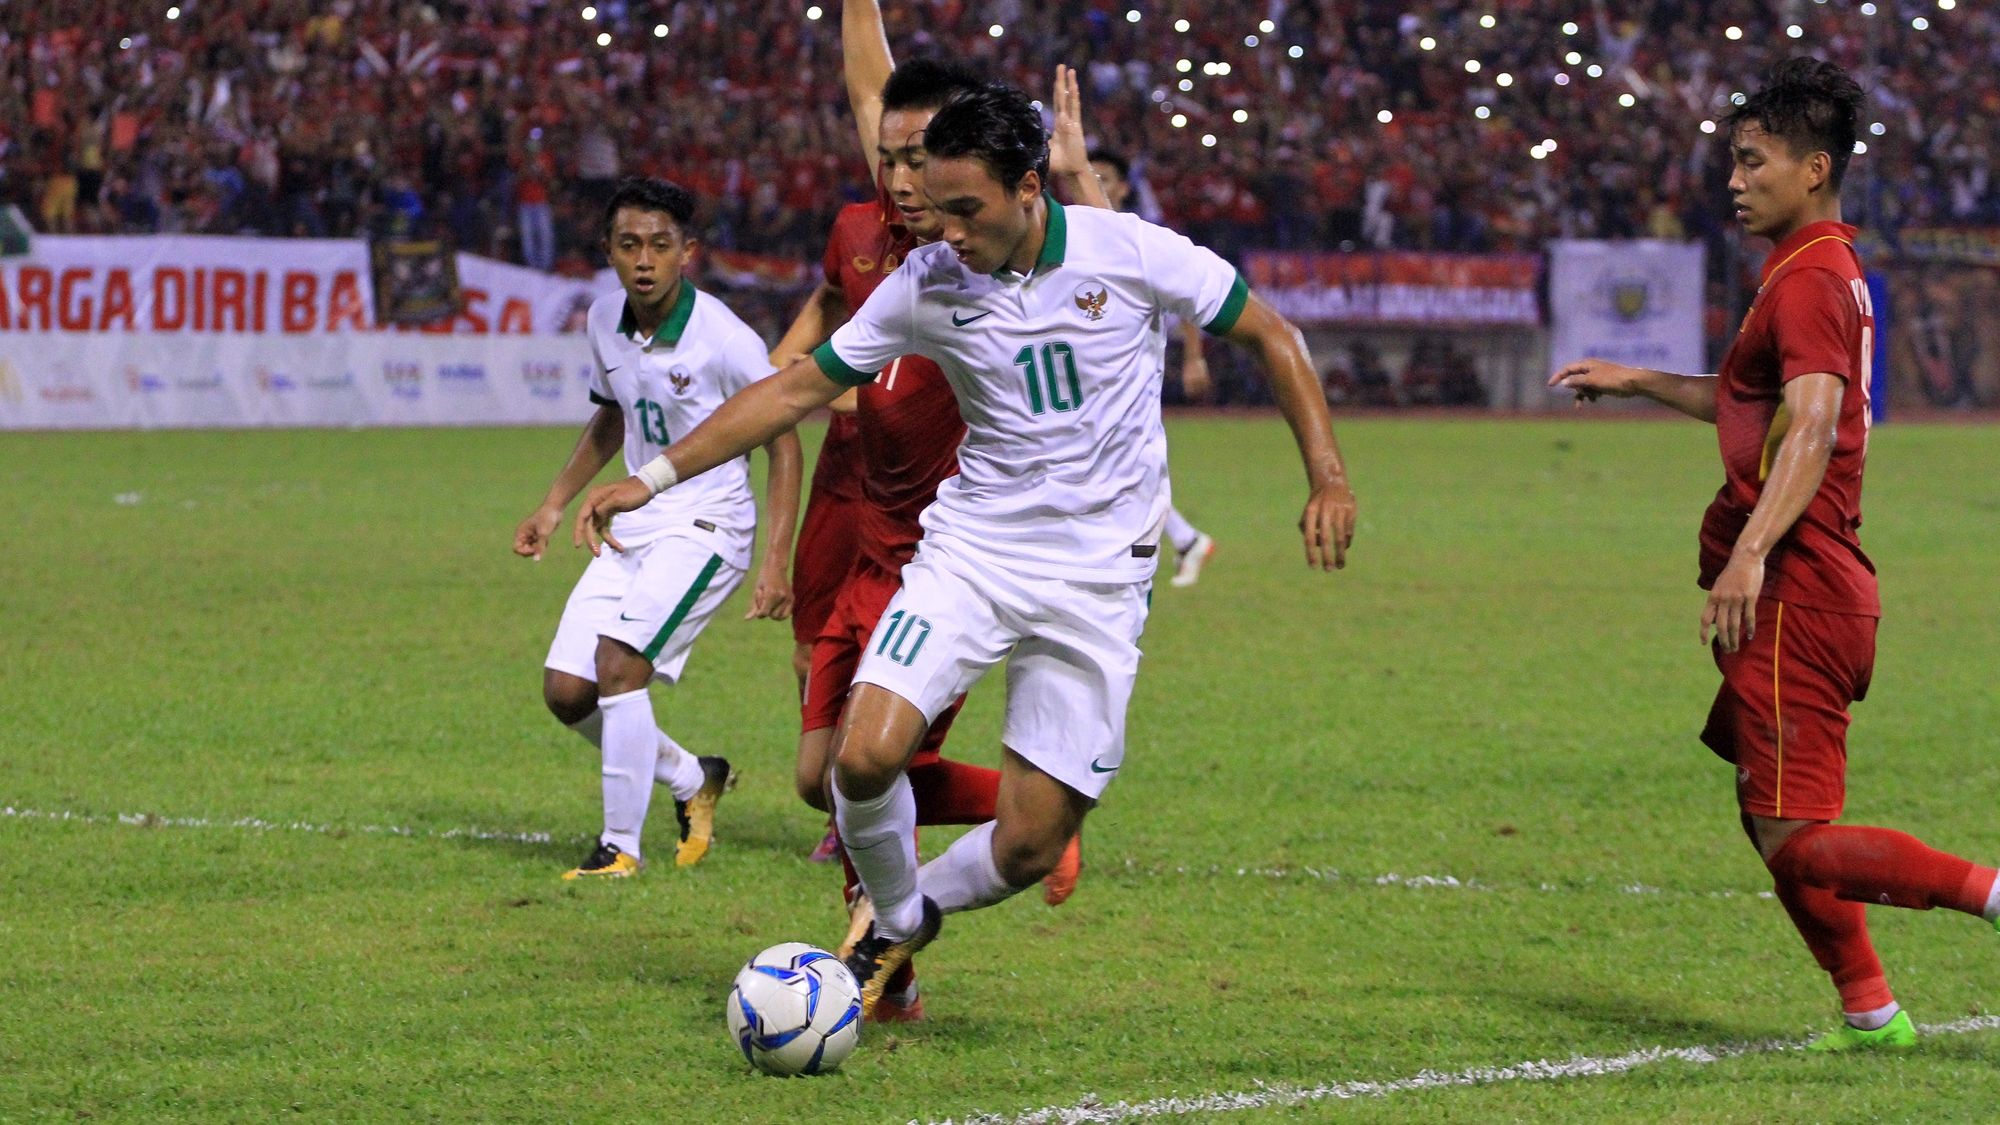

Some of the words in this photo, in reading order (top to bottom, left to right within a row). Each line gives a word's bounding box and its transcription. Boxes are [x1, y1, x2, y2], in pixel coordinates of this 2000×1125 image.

[153, 267, 267, 332] DIRI
[282, 269, 532, 334] BASA
[1013, 341, 1085, 416] 10
[634, 398, 670, 446] 13
[875, 609, 933, 667] 10
